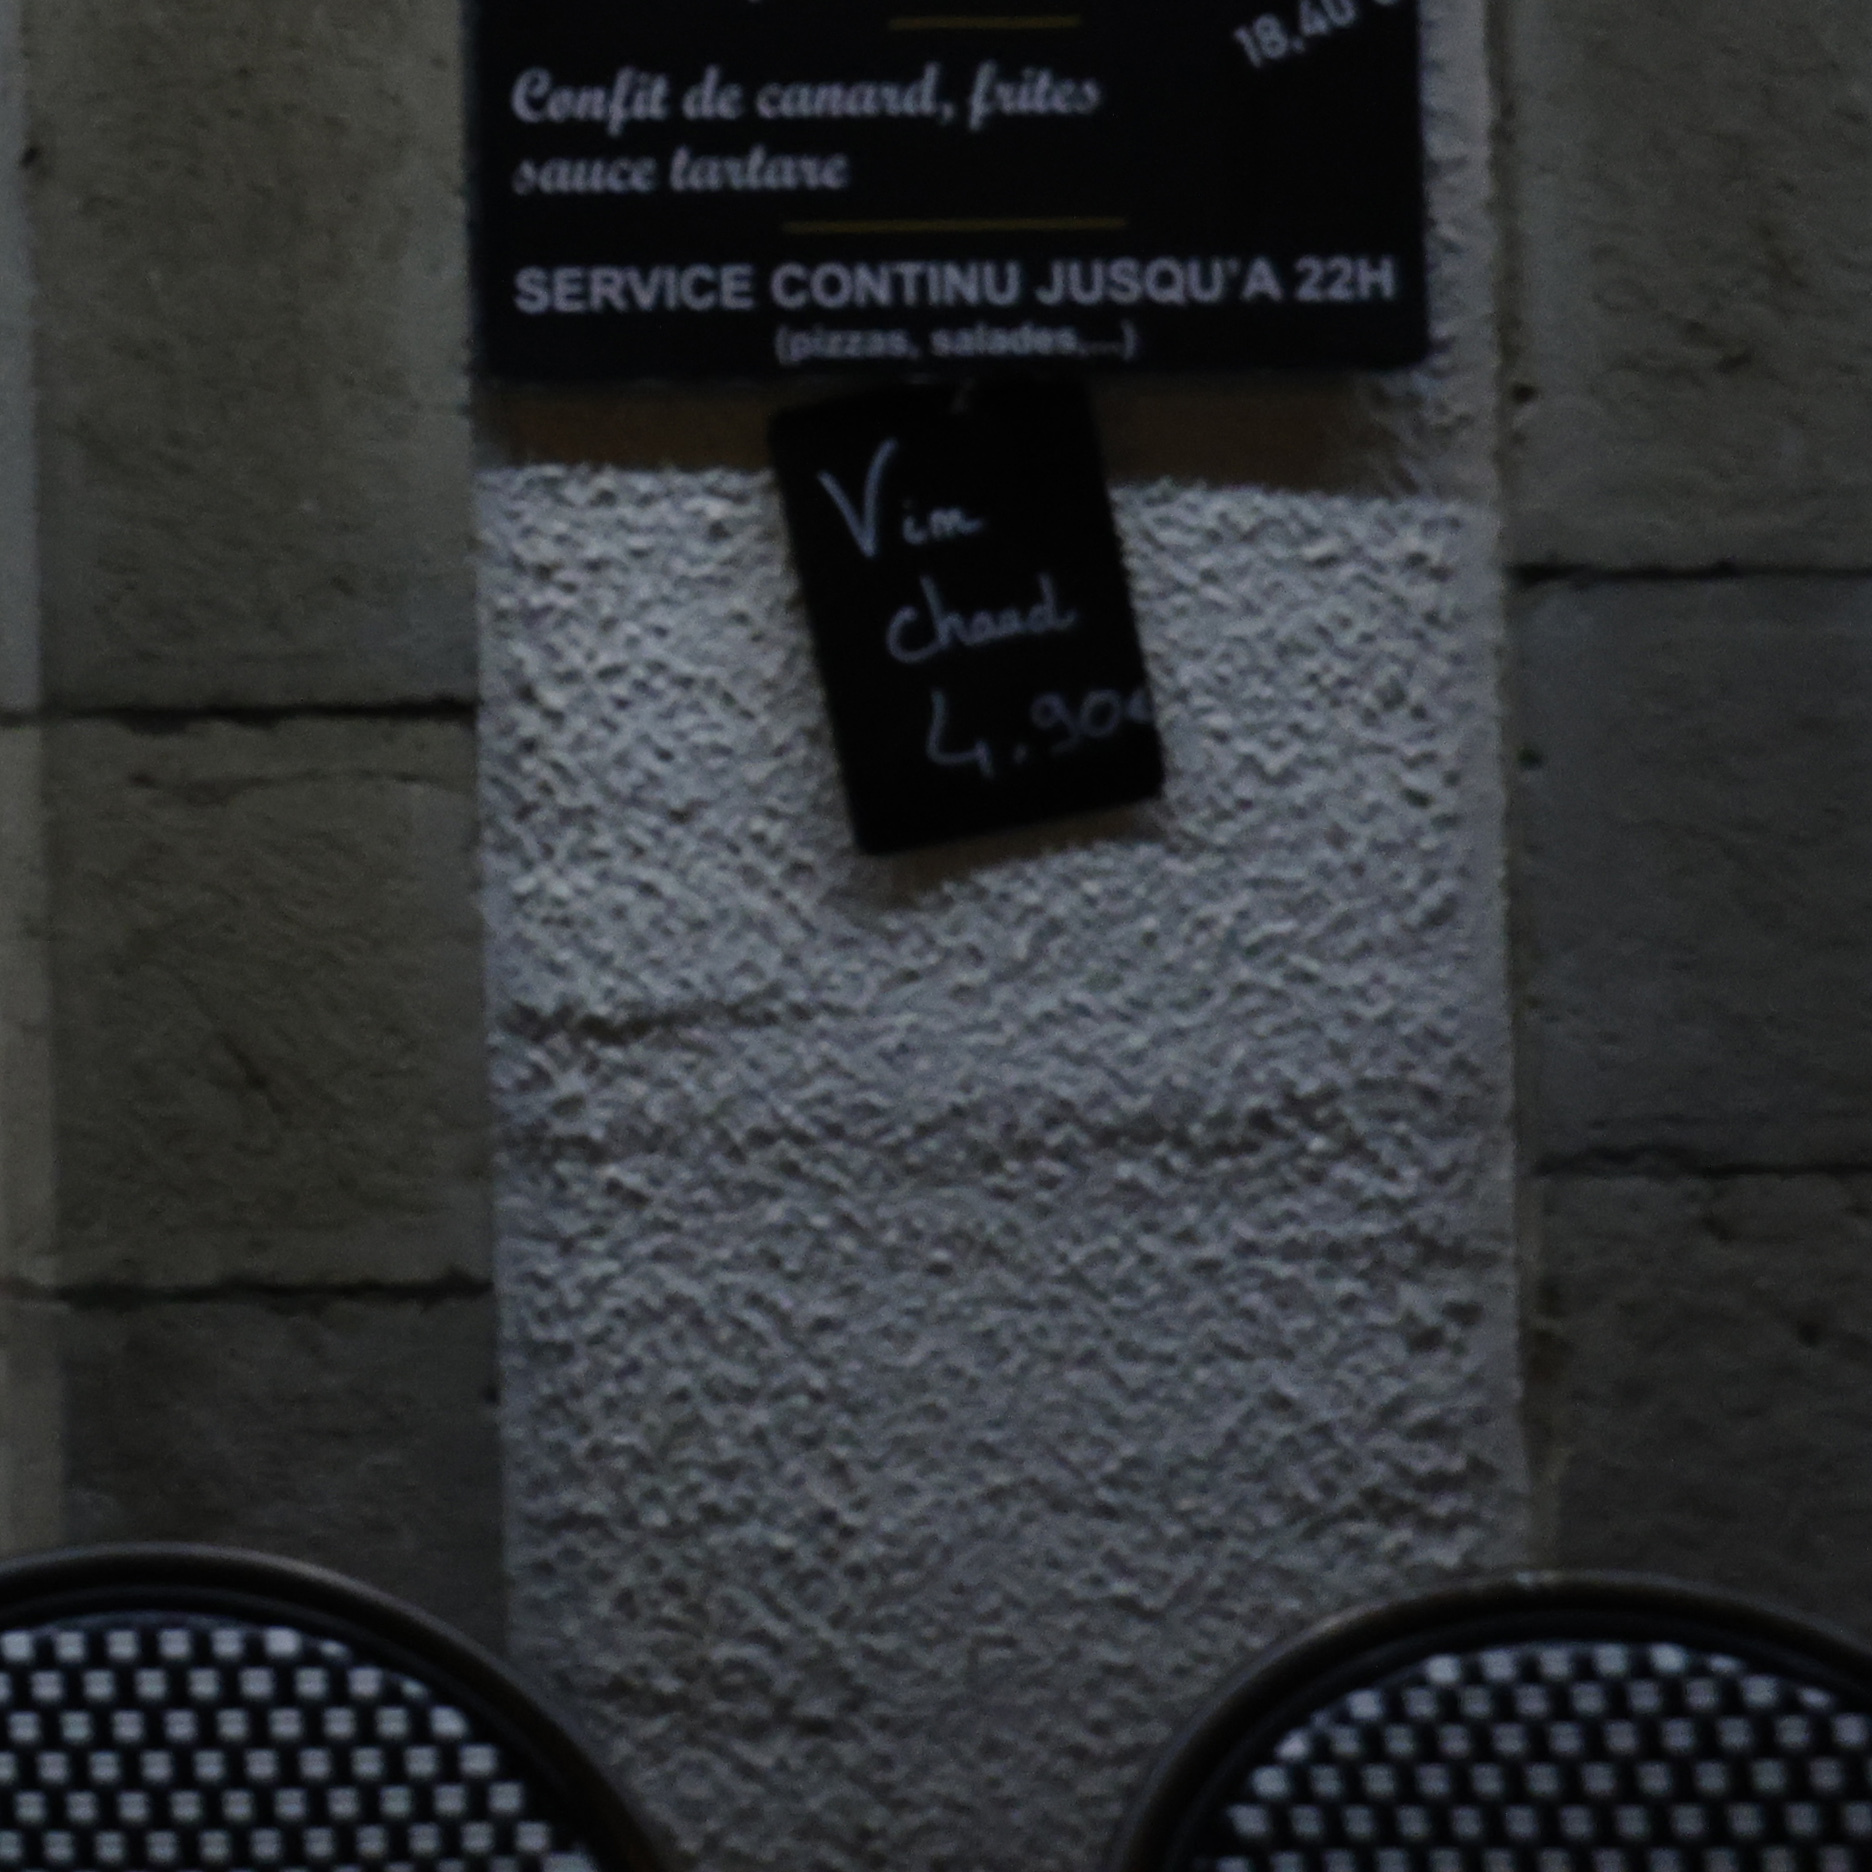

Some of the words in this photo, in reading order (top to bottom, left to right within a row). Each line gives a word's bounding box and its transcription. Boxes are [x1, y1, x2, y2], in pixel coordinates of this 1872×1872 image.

[511, 67, 668, 136] Confit
[682, 66, 742, 119] de
[756, 63, 955, 121] canard,
[968, 62, 1100, 130] frites
[514, 158, 656, 194] sauce
[669, 145, 847, 191] tartare
[515, 264, 754, 314] SERVICE
[770, 261, 1021, 309] CONTINU
[1036, 257, 1283, 305] JUSQU'A
[1295, 256, 1396, 302] 22H
[818, 439, 983, 558] Vin
[886, 574, 1076, 663] chaud
